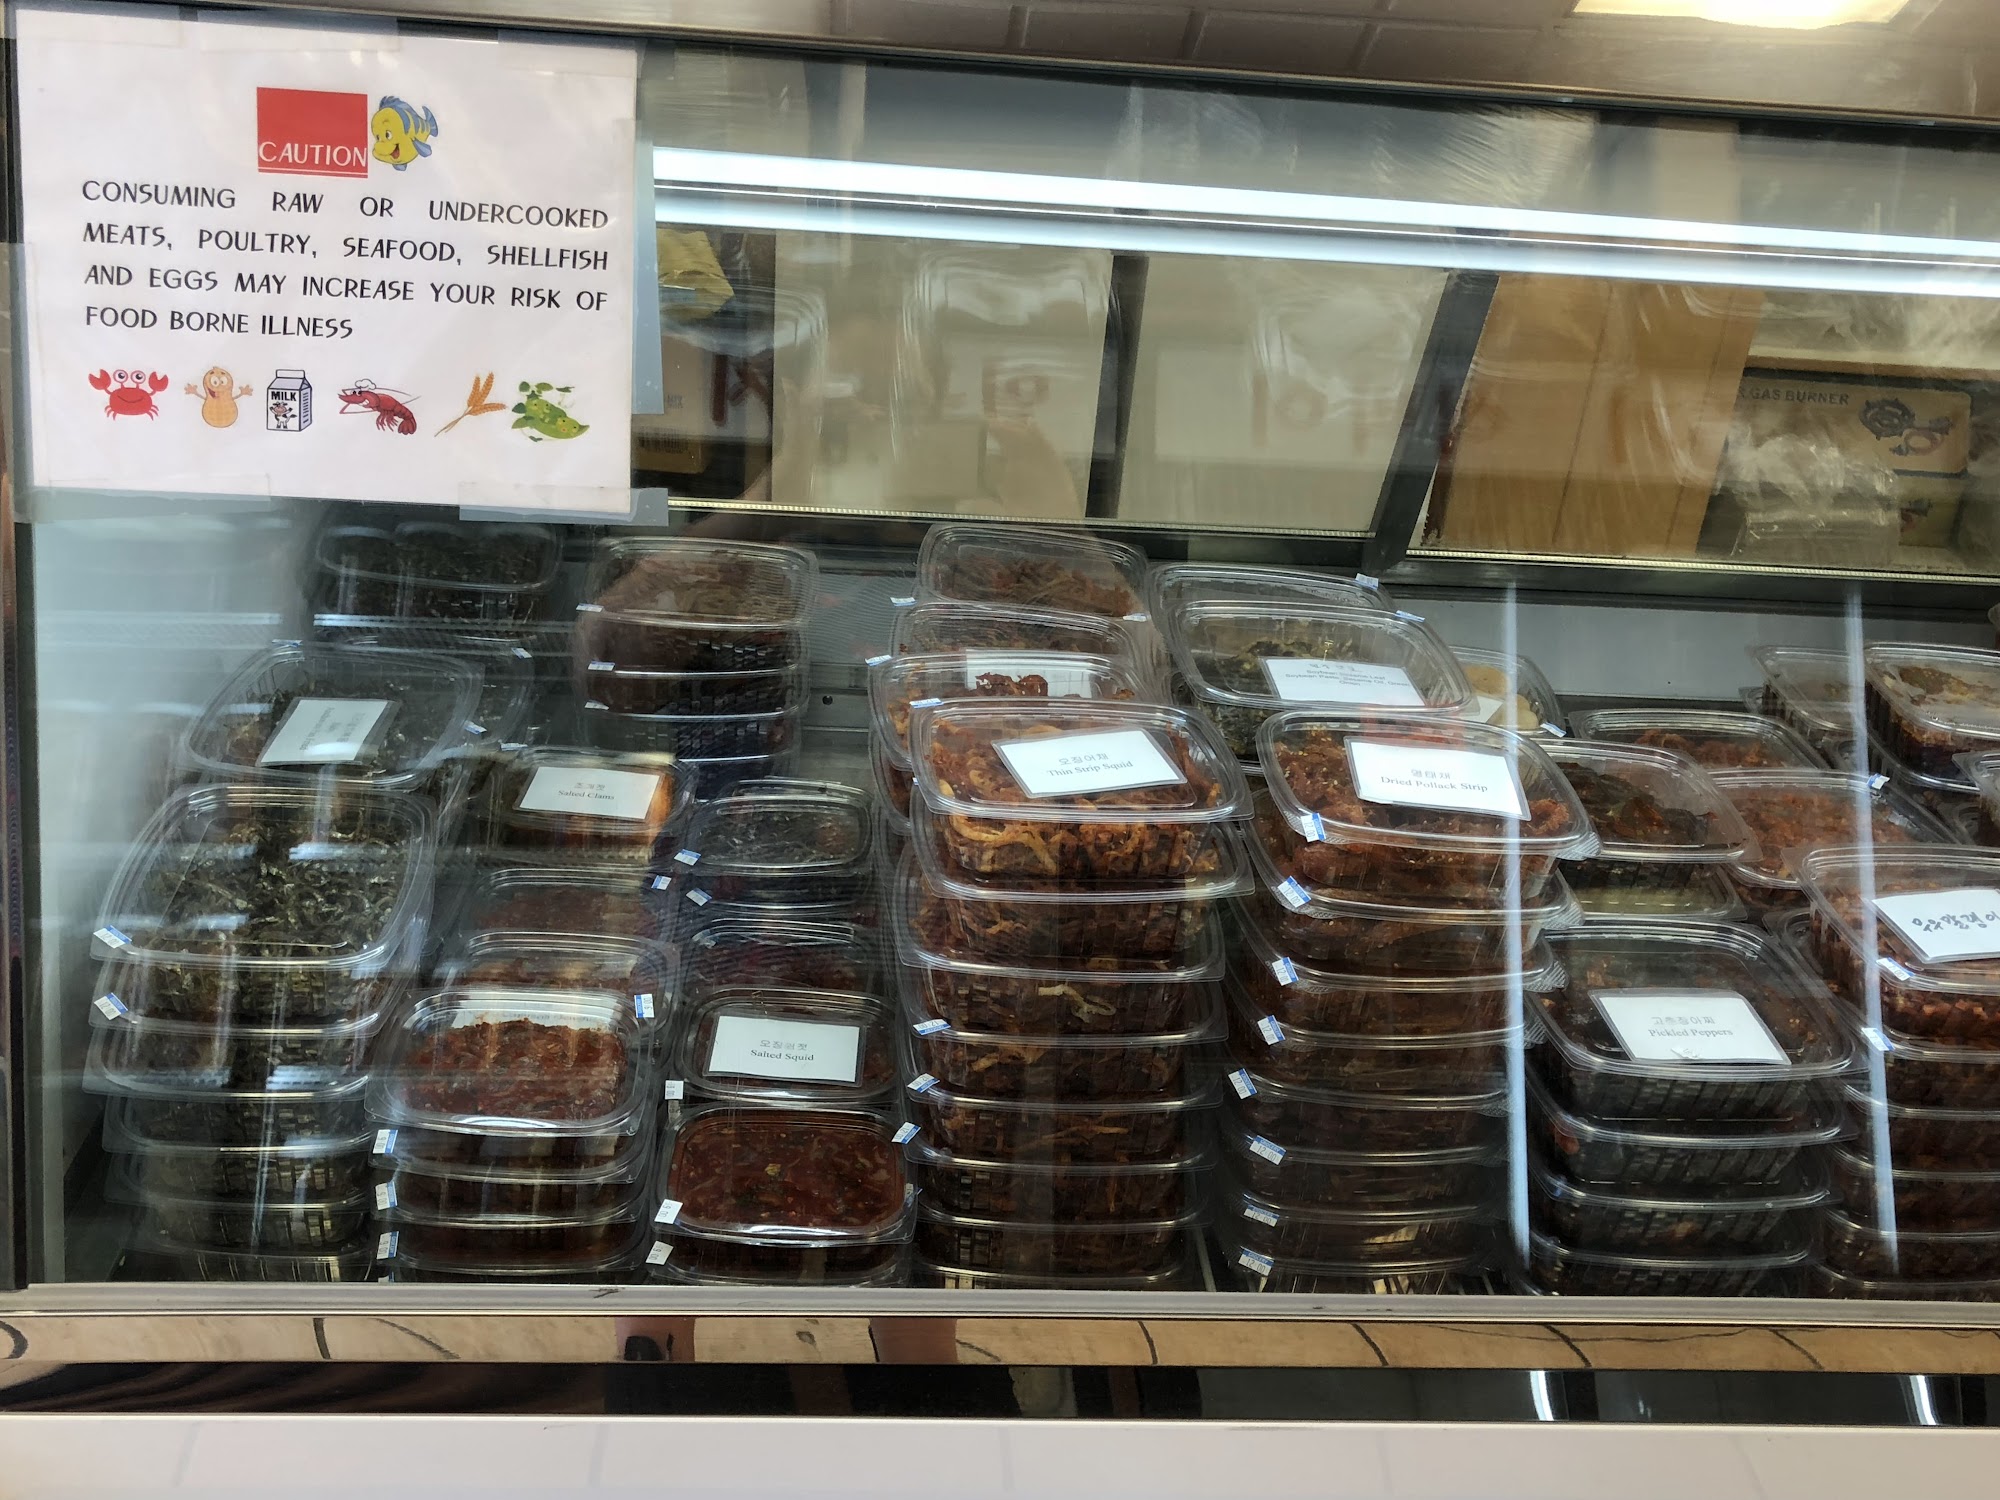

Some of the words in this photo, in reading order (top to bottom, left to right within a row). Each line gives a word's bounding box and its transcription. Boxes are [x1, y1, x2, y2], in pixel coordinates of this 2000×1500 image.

[258, 140, 366, 168] CAUTION
[83, 181, 235, 208] CONSUMING
[273, 192, 323, 213] RAW
[360, 197, 393, 217] OR
[430, 201, 608, 228] UNDERCOOKED
[83, 223, 171, 250] MEATS,
[199, 229, 316, 258] POULTRY,
[344, 238, 460, 265] SEAFOOD,
[488, 245, 607, 270] SHELLFISH
[85, 265, 132, 285] AND
[150, 268, 217, 291] EGGS
[235, 273, 286, 294] MAY
[303, 276, 414, 300] INCREASE
[430, 283, 495, 304] YOUR
[512, 287, 560, 308] RISK
[577, 291, 607, 310] OF
[87, 306, 157, 328] FOOD
[170, 311, 248, 333] BORNE
[262, 315, 352, 338] ILLNESS
[271, 391, 296, 402] MILK
[1751, 388, 1780, 400] GAS
[1786, 390, 1849, 406] BURNER
[1047, 768, 1074, 777] Thin
[1075, 764, 1100, 774] Strip
[1103, 760, 1133, 772] Squid
[1381, 776, 1412, 786] Dried
[1416, 780, 1457, 790] Pollack
[1460, 783, 1488, 793] Strip
[558, 790, 586, 798] Salted
[587, 792, 614, 800] Clams
[1648, 1028, 1689, 1037] Pickled
[1690, 1028, 1733, 1038] Peppers
[750, 1050, 782, 1060] Salted
[784, 1053, 814, 1062] Squid
